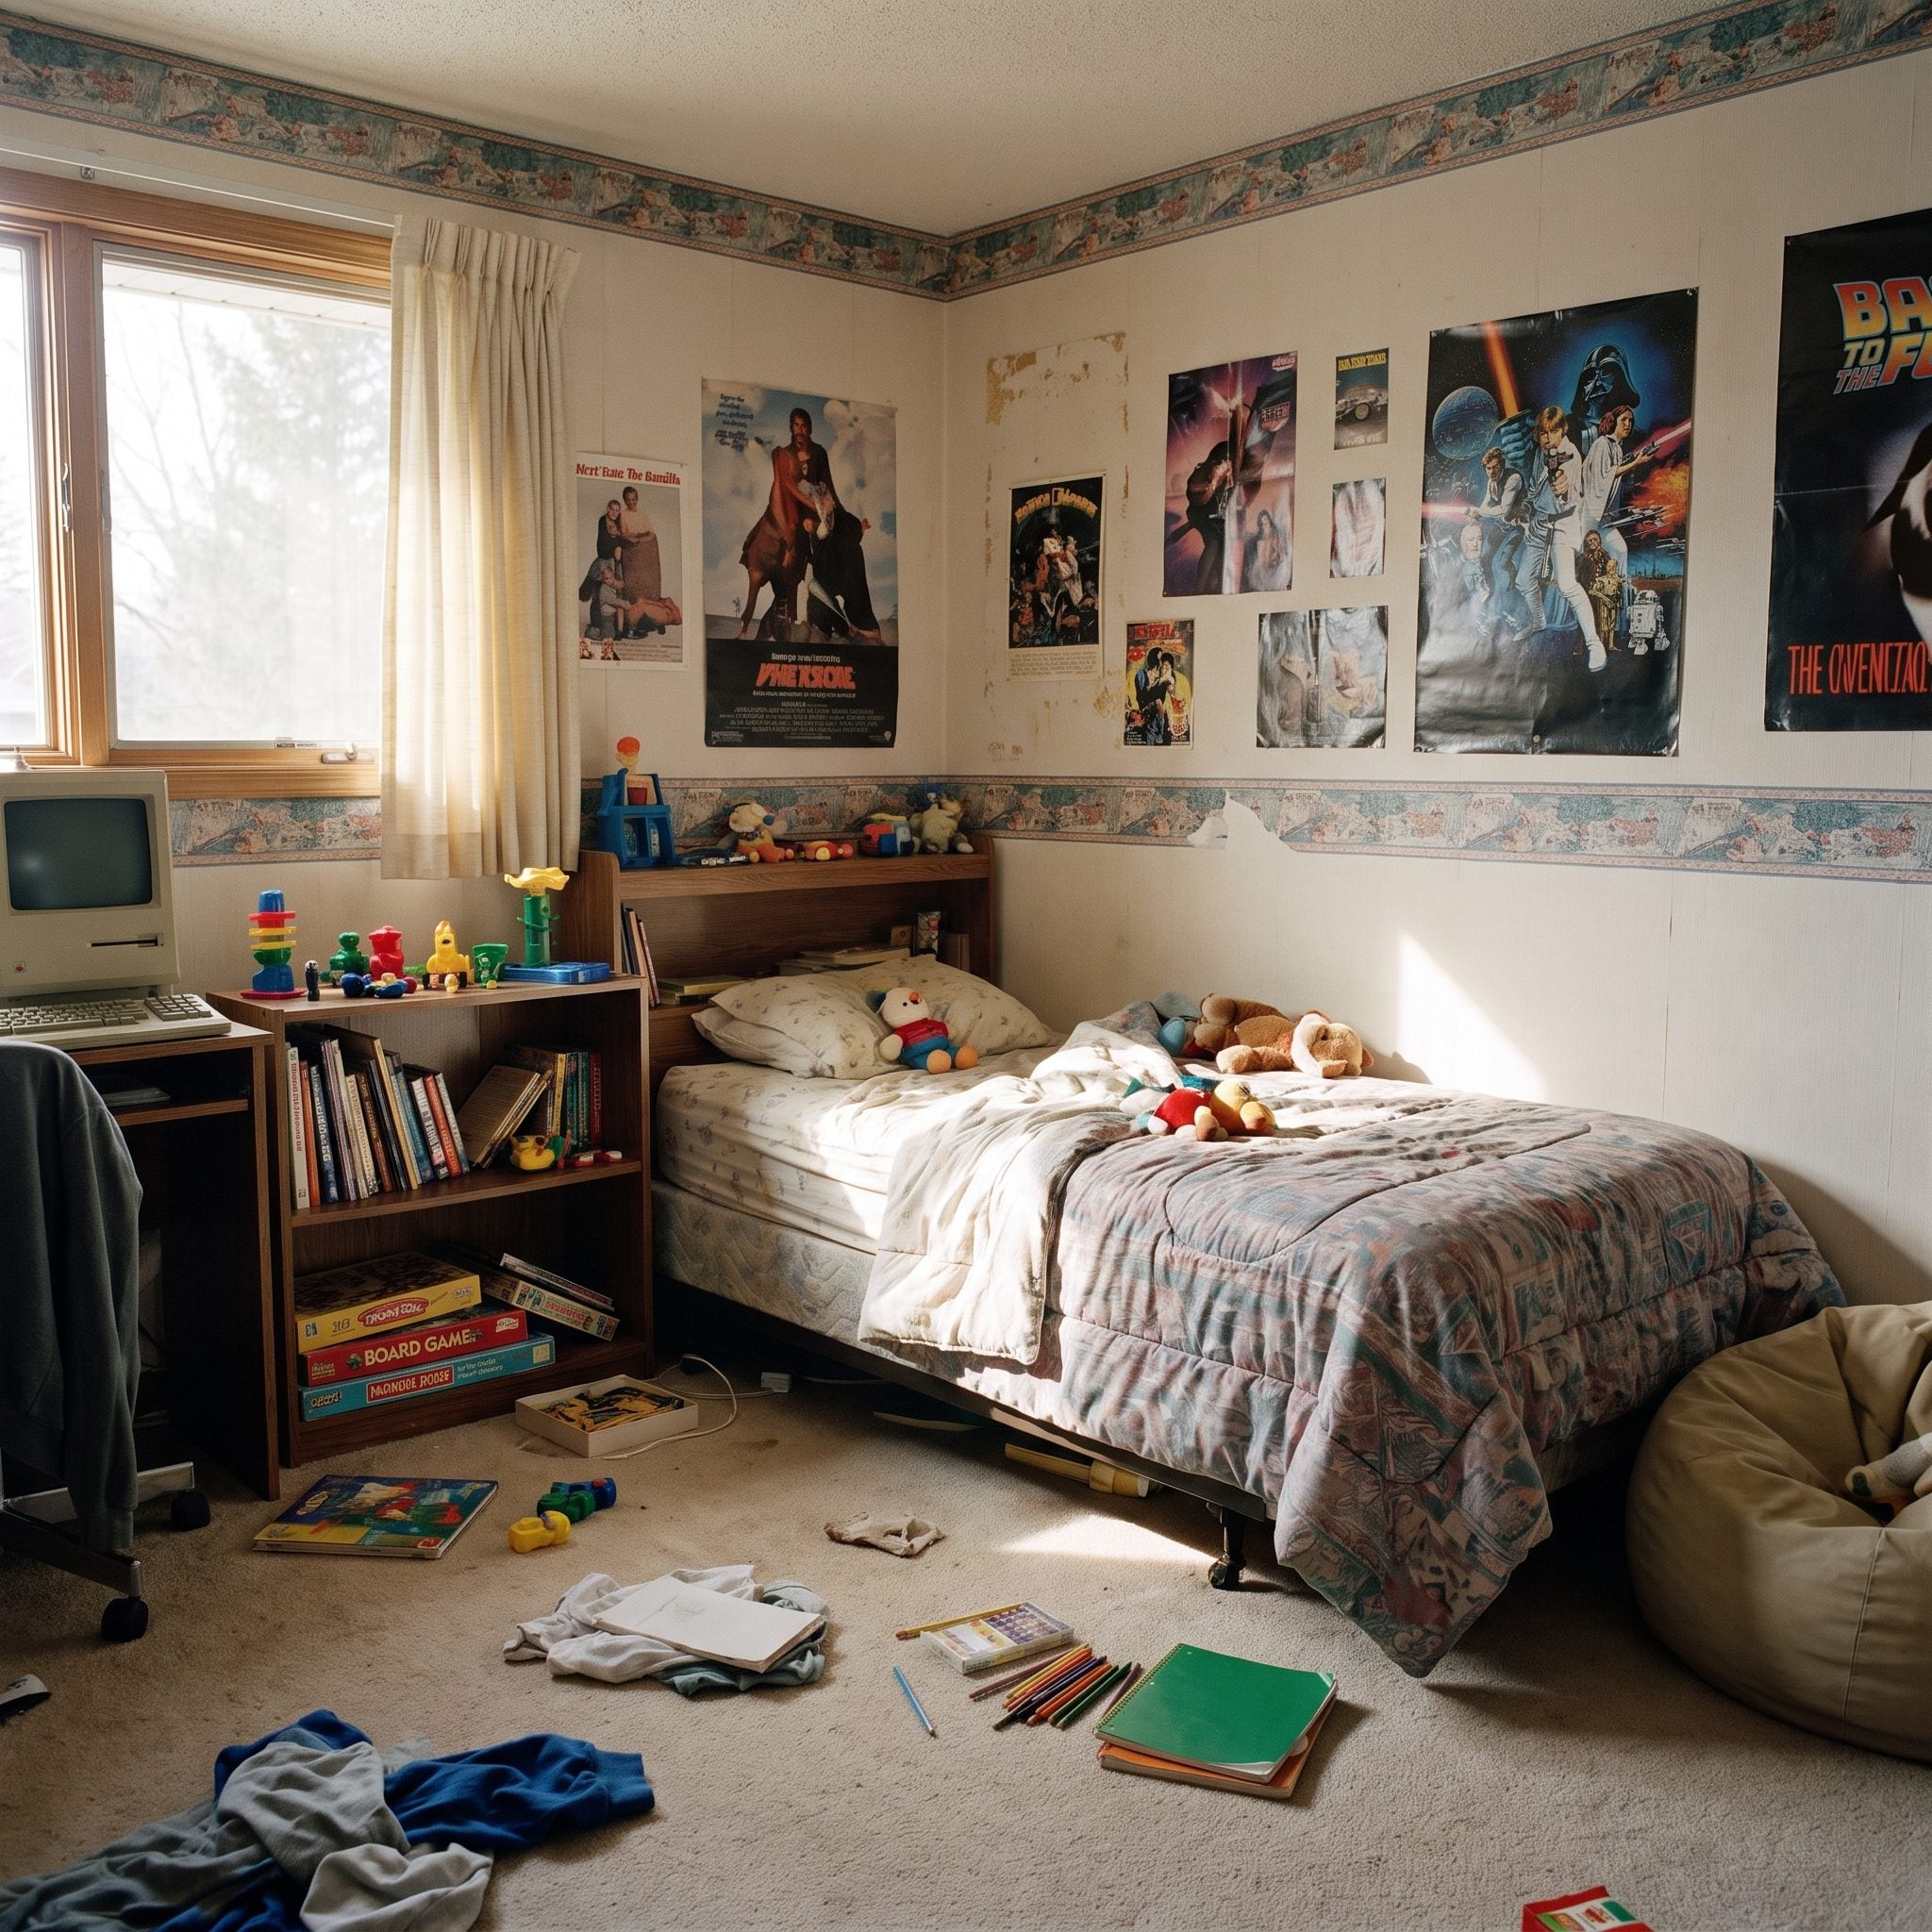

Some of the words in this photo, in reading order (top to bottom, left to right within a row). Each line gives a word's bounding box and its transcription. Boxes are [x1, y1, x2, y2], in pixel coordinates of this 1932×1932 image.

[1832, 275, 1932, 341] BA
[1842, 338, 1886, 369] TO
[1833, 364, 1883, 395] THE
[1788, 644, 1824, 695] THE
[364, 1340, 422, 1367] BOARD
[424, 1328, 472, 1353] GAME
